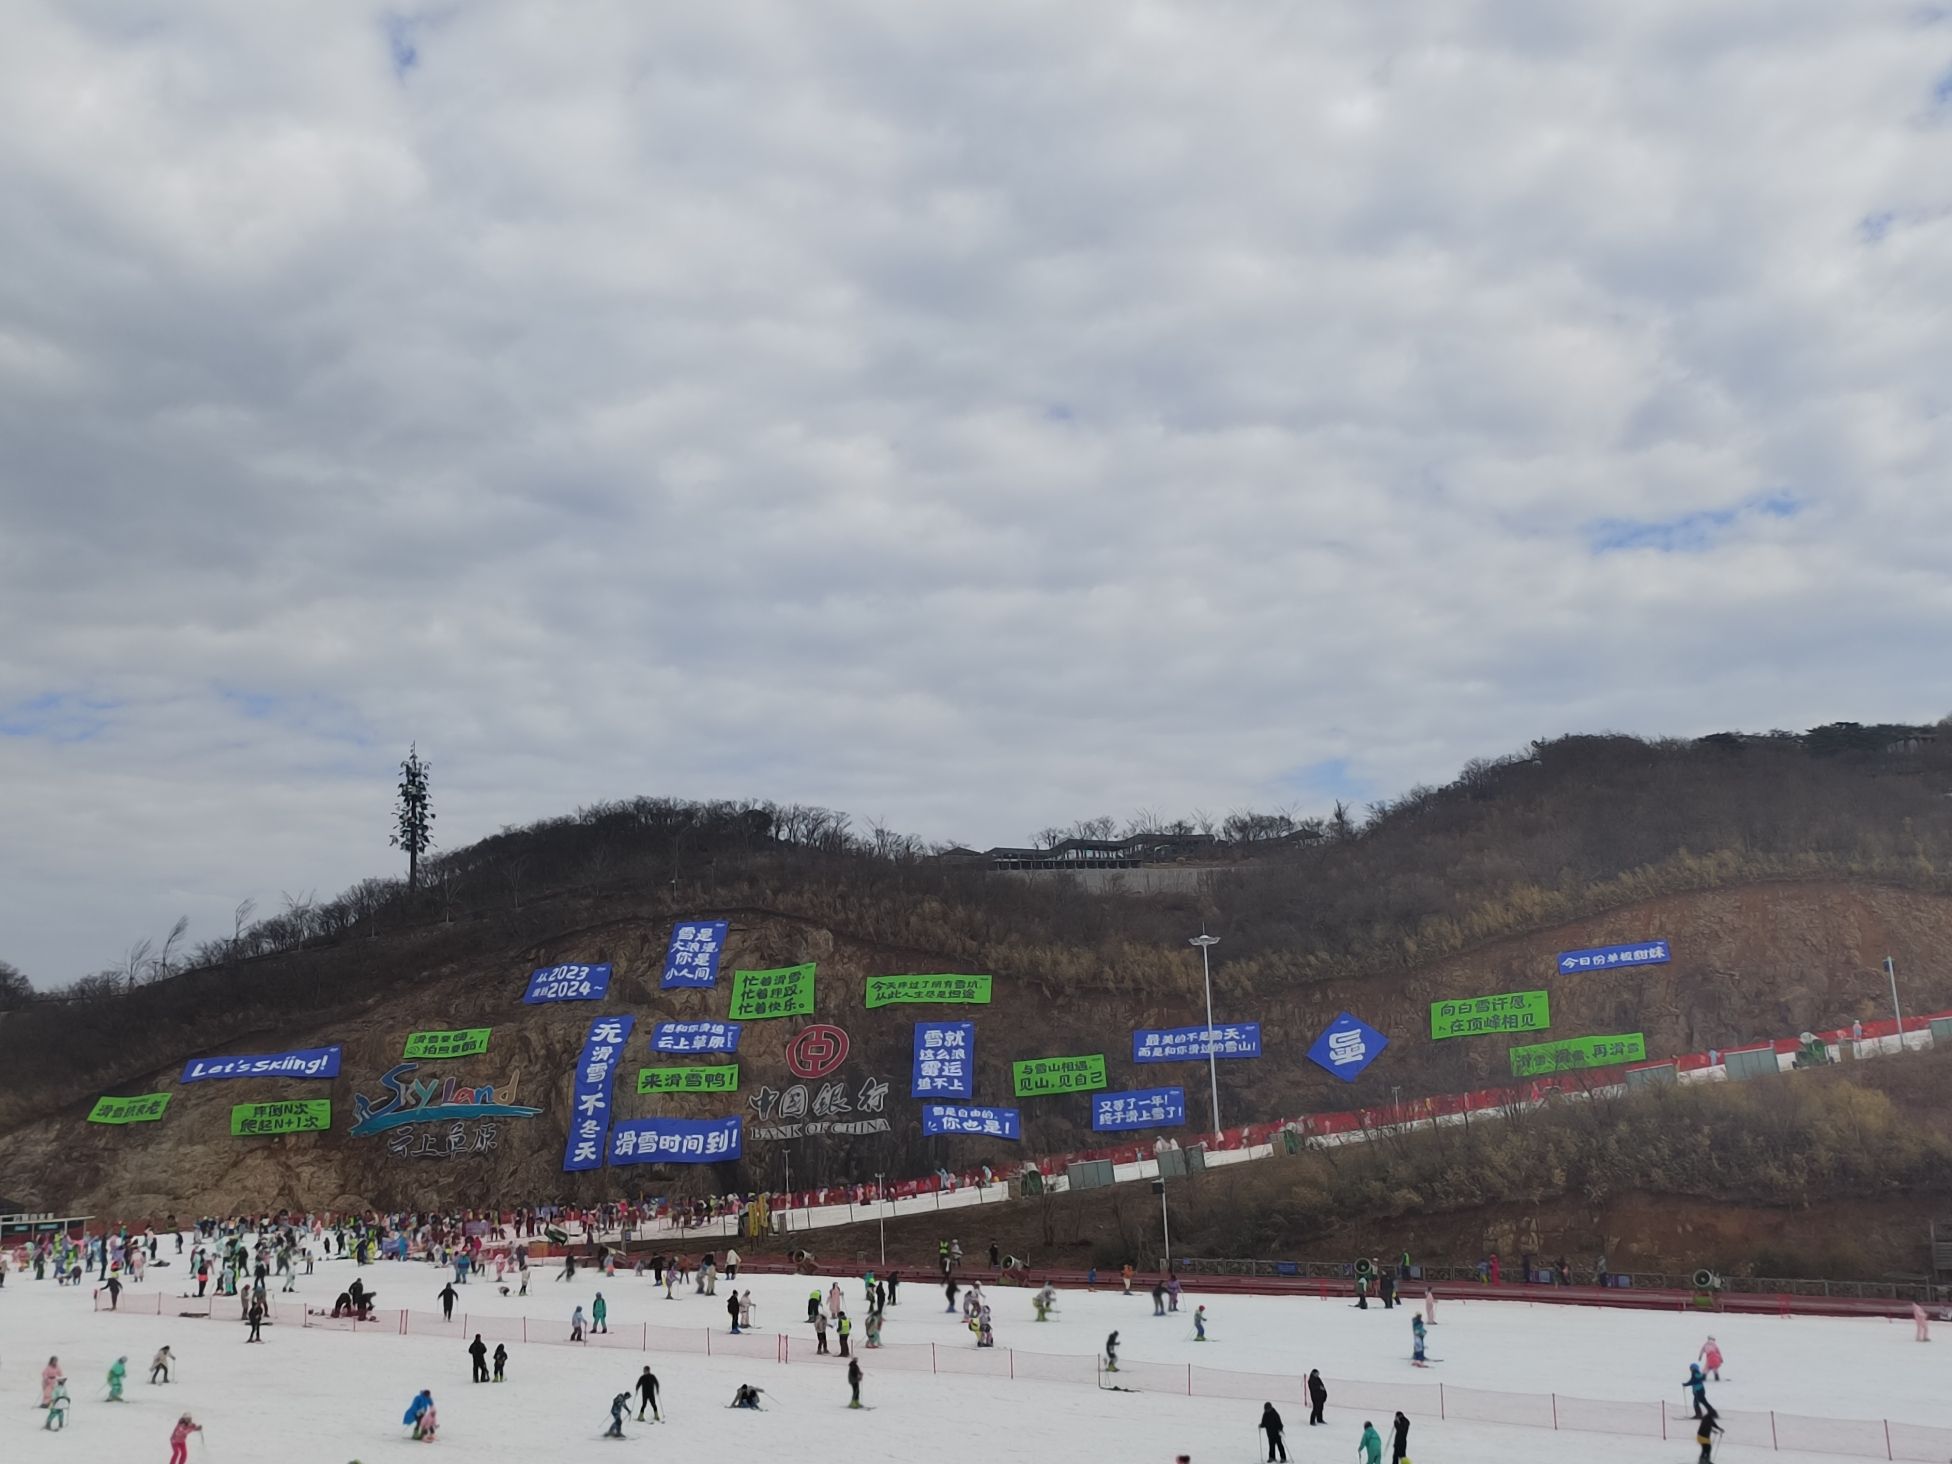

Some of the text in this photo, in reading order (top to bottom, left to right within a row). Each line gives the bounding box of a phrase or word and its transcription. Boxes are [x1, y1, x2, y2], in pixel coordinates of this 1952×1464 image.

[675, 951, 710, 966] 你是
[536, 965, 590, 984] 从2023
[1450, 1012, 1537, 1034] 在顶峰相见
[657, 1034, 725, 1050] 云上草原
[924, 1029, 966, 1048] 雪就
[919, 1048, 966, 1061] 这么浪
[641, 1072, 735, 1089] 来滑雪鸭！
[916, 1077, 965, 1091] 追不上
[1020, 1071, 1104, 1092] 见山，见自己
[942, 1116, 1010, 1134] 你也是！
[1099, 1106, 1182, 1125] 终于滑上雪了！
[750, 1118, 891, 1140] BANK OF CHINA
[614, 1128, 738, 1156] 滑雪时间到！
